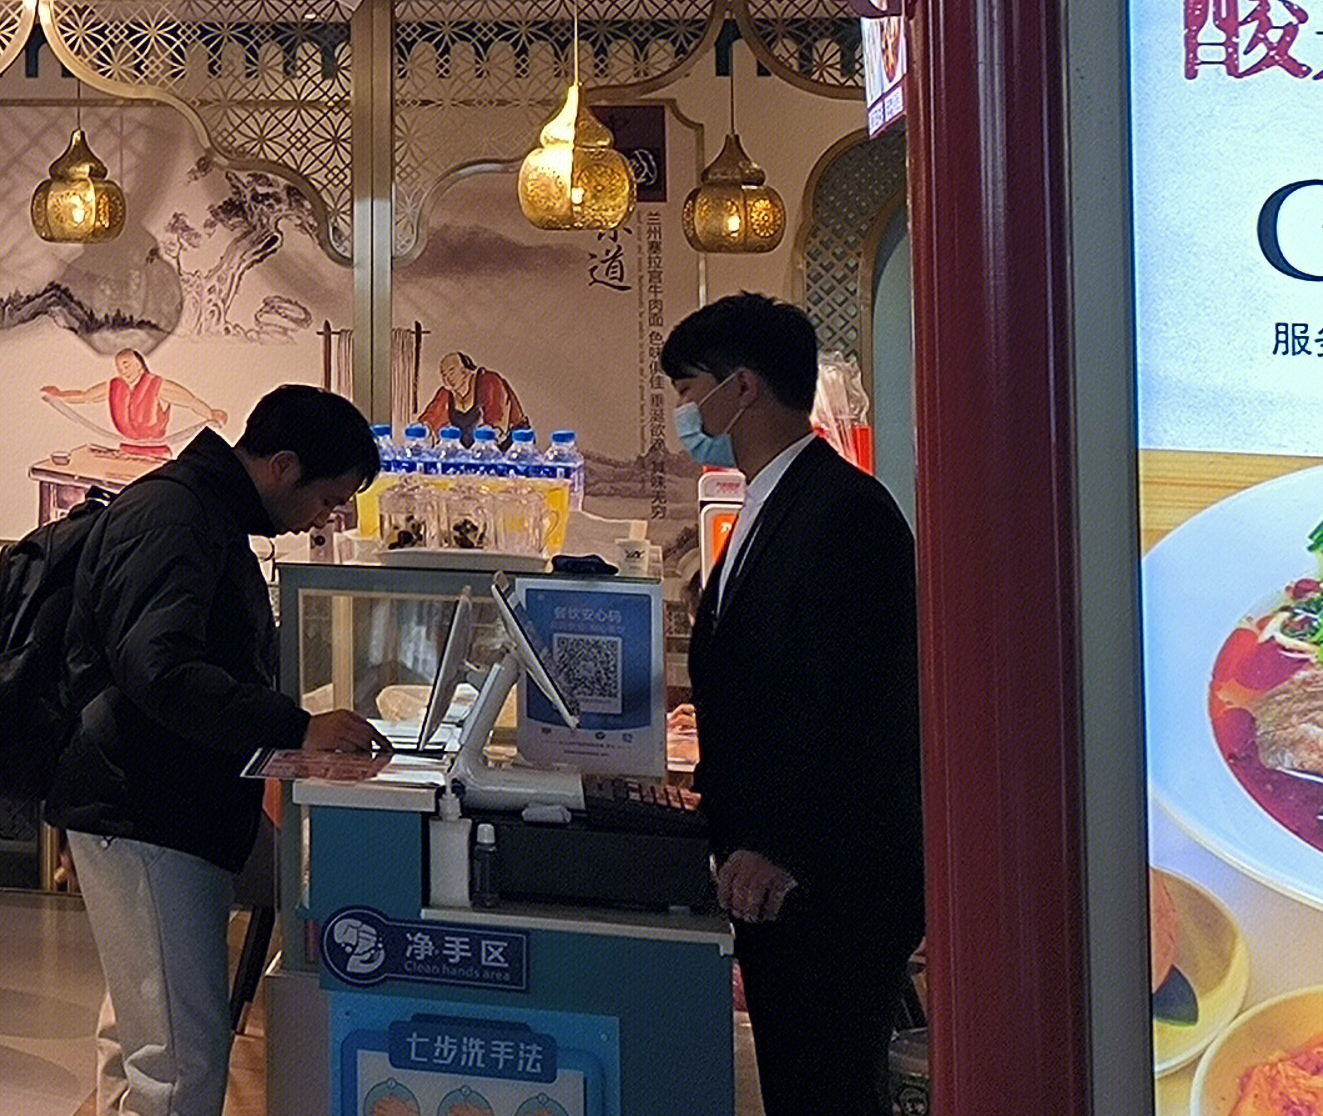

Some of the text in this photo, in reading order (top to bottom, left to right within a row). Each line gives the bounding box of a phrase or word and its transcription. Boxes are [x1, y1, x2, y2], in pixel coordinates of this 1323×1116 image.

[1272, 322, 1323, 358] 服
[404, 960, 440, 975] Clean
[405, 932, 509, 968] 净手区
[407, 1032, 543, 1074] 七步洗手法
